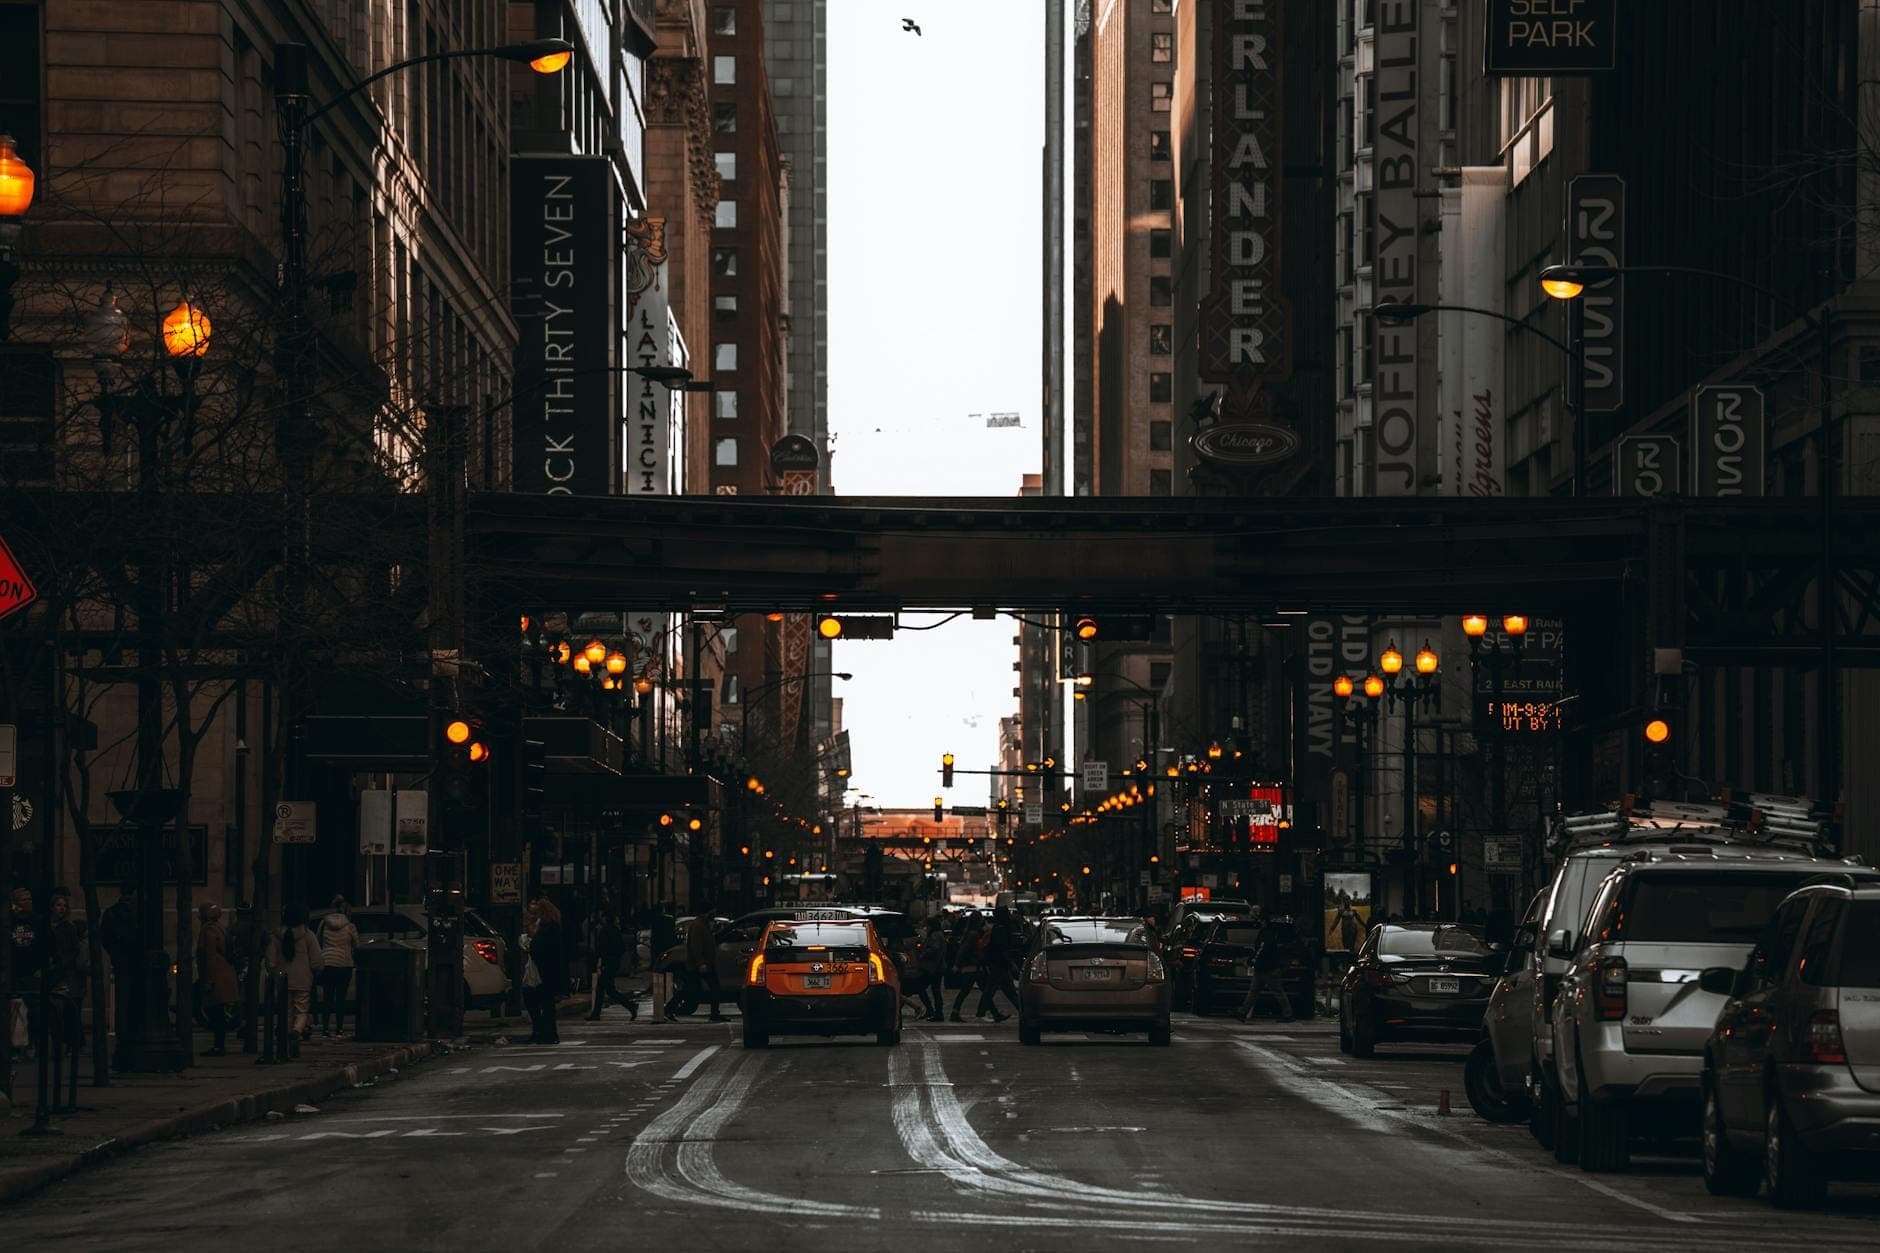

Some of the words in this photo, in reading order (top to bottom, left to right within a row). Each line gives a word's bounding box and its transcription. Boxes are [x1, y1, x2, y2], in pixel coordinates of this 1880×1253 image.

[1508, 20, 1597, 48] PARK
[544, 175, 575, 288] SEVEN
[544, 301, 575, 421] THIRTY
[1219, 432, 1274, 455] Chicago
[1308, 620, 1333, 677] OLD
[1503, 680, 1532, 689] EAST
[1308, 683, 1333, 758] NAVY
[495, 865, 519, 876] ONE
[495, 876, 520, 889] WAY
